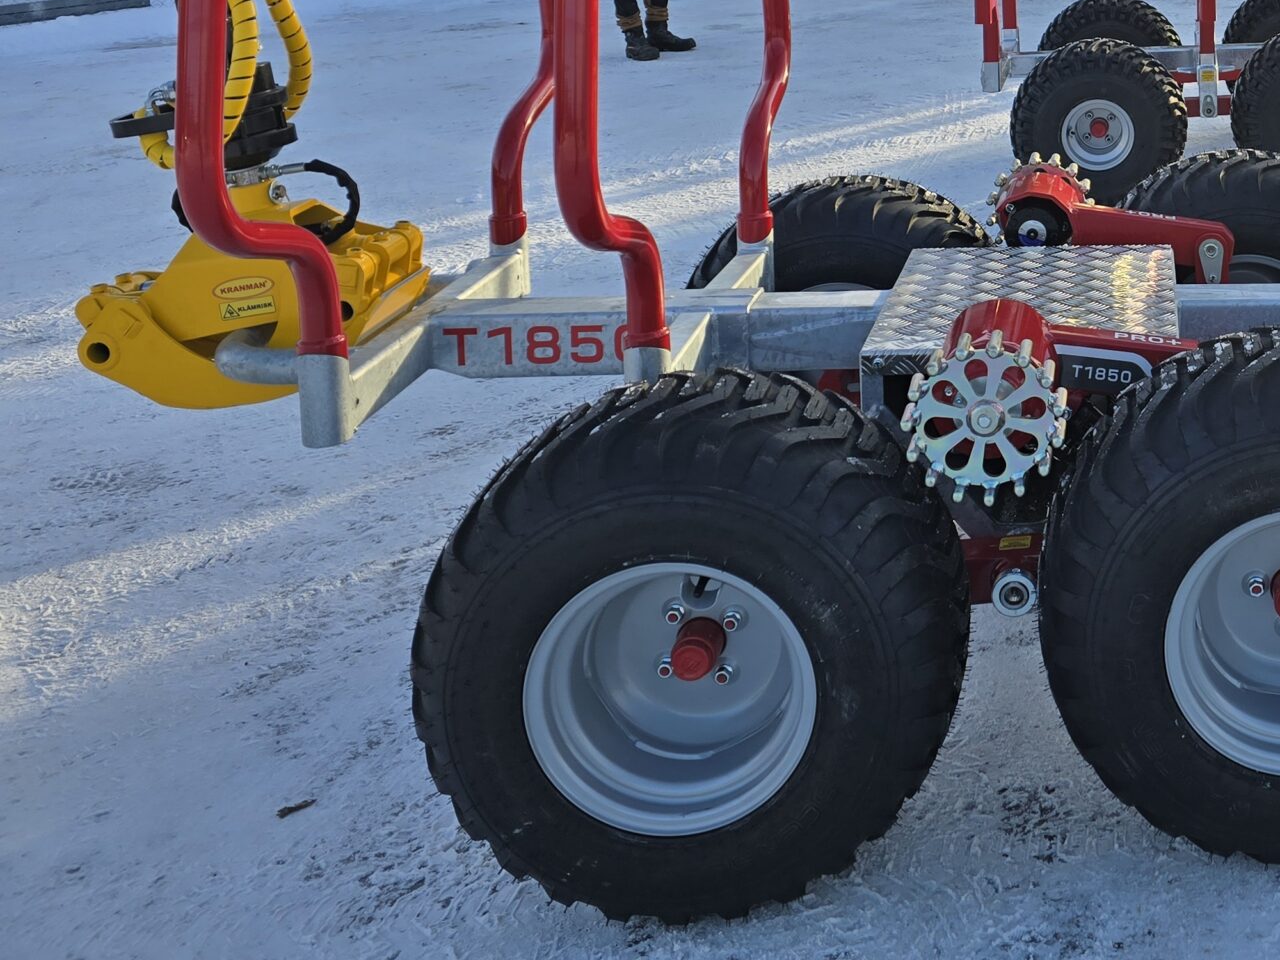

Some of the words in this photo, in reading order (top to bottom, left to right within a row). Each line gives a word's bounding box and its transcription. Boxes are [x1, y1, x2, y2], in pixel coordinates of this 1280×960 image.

[220, 281, 267, 295] KRANMAN
[1114, 332, 1182, 346] PRO+
[1072, 364, 1132, 384] T1850
